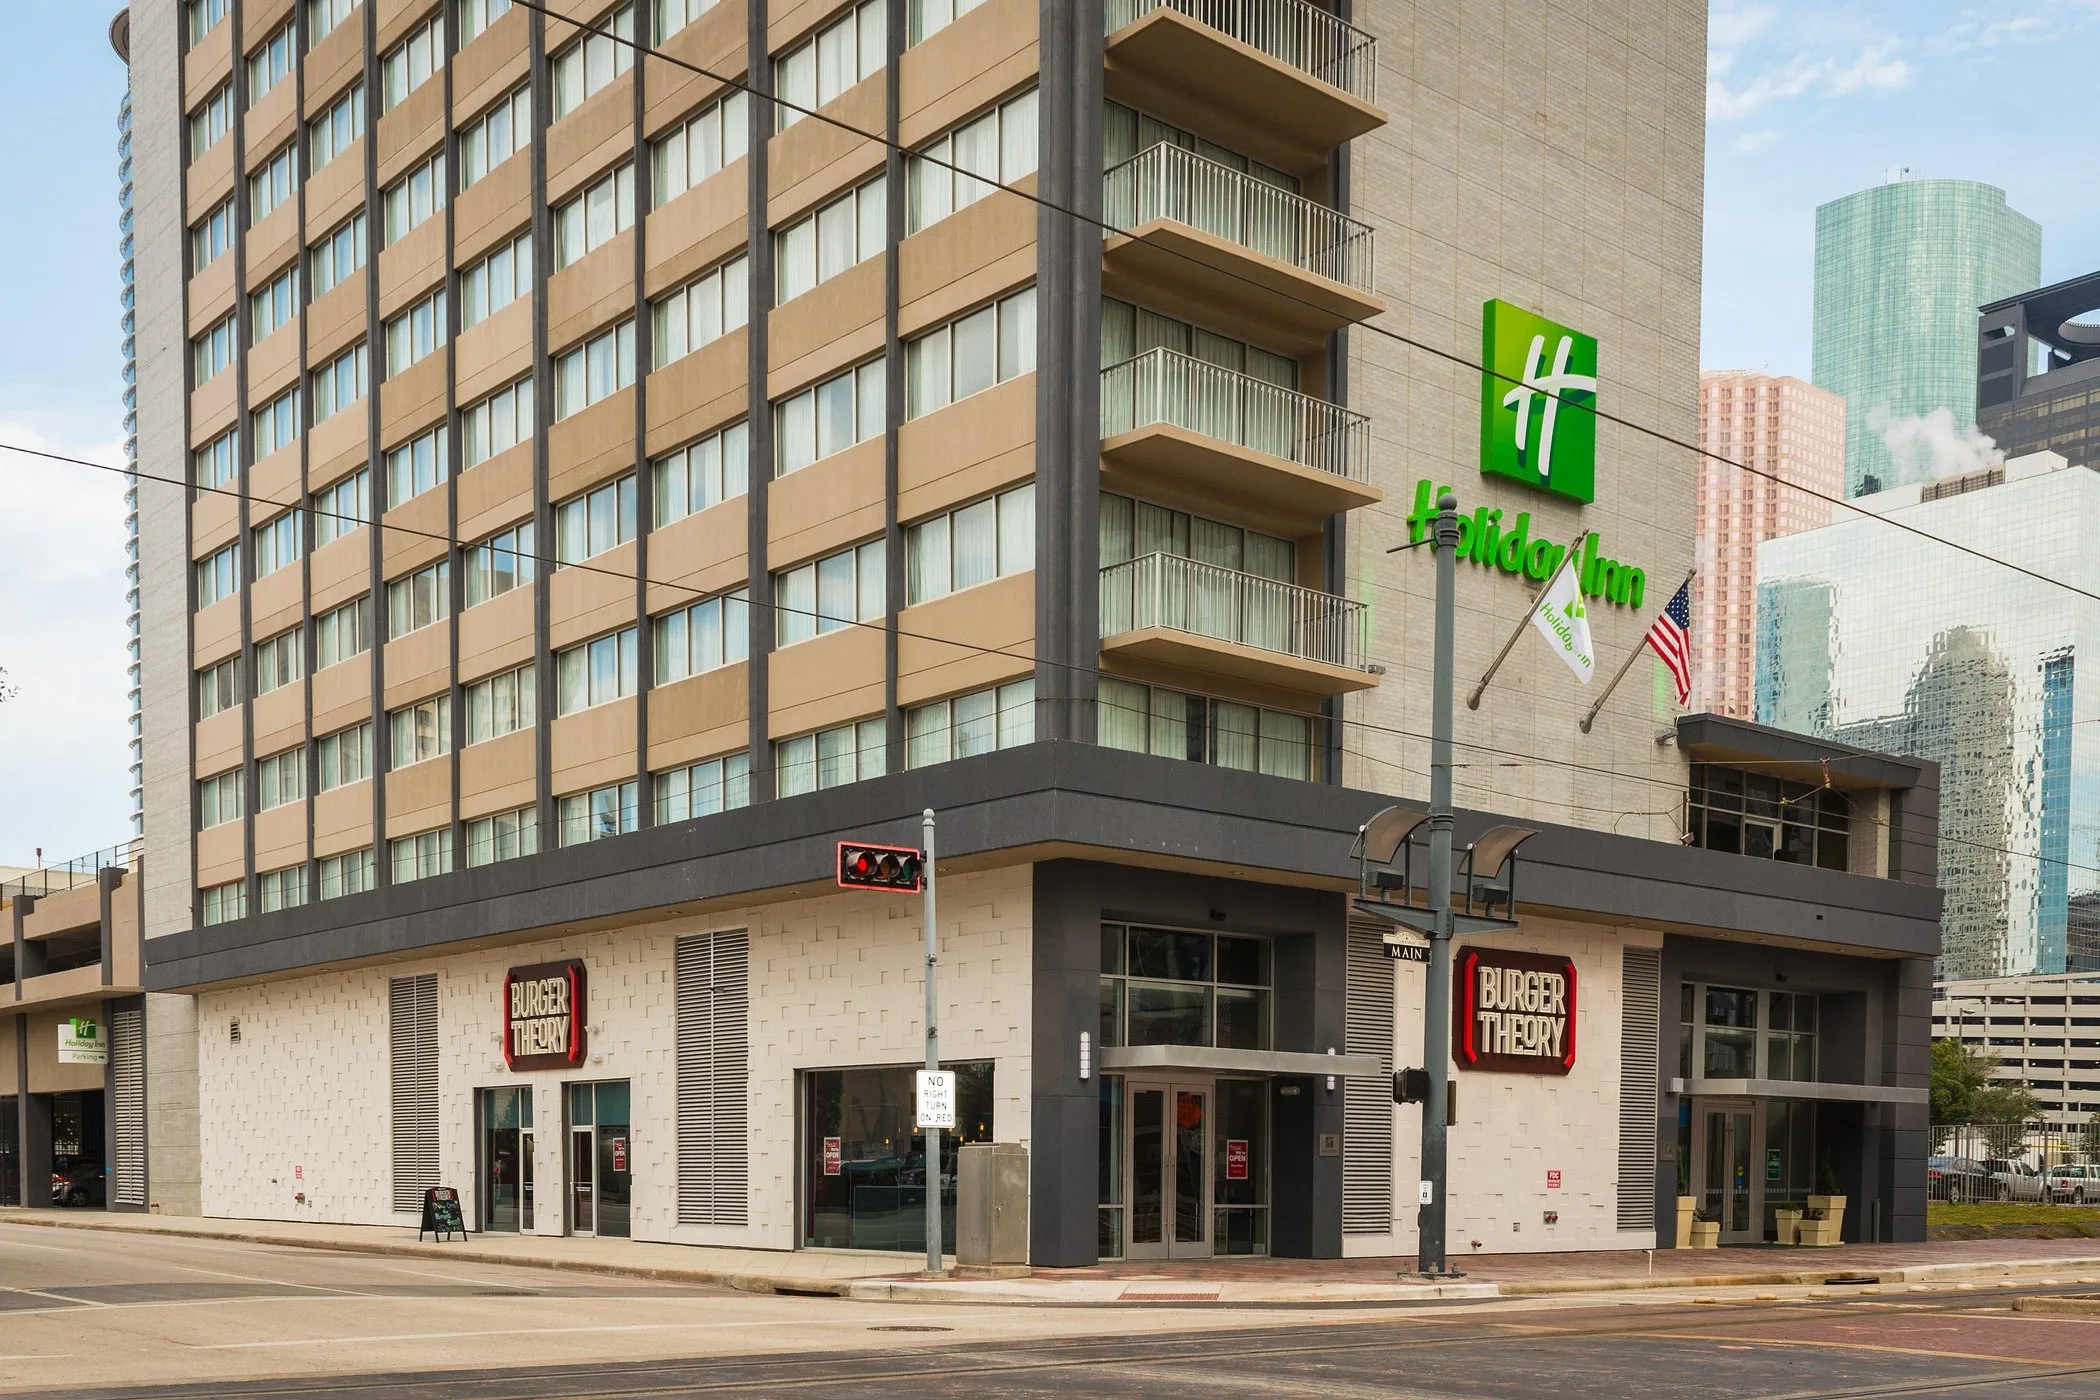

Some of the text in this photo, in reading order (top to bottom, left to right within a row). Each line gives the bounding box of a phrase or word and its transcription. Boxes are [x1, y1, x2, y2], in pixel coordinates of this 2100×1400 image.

[1580, 532, 1646, 609] Inn
[1391, 945, 1422, 960] MAIN
[1478, 966, 1566, 1015] BURGER
[510, 977, 570, 1018] BURGER
[510, 1016, 570, 1056] THEORY
[1477, 1011, 1566, 1058] THEORY
[65, 1039, 105, 1049] Holiday Inn
[72, 1053, 97, 1061] Parking
[928, 1076, 944, 1087] NO
[923, 1089, 947, 1099] RIGHT
[926, 1101, 947, 1110] TURN
[920, 1112, 952, 1122] ON RED
[1229, 1154, 1246, 1162] OPEN
